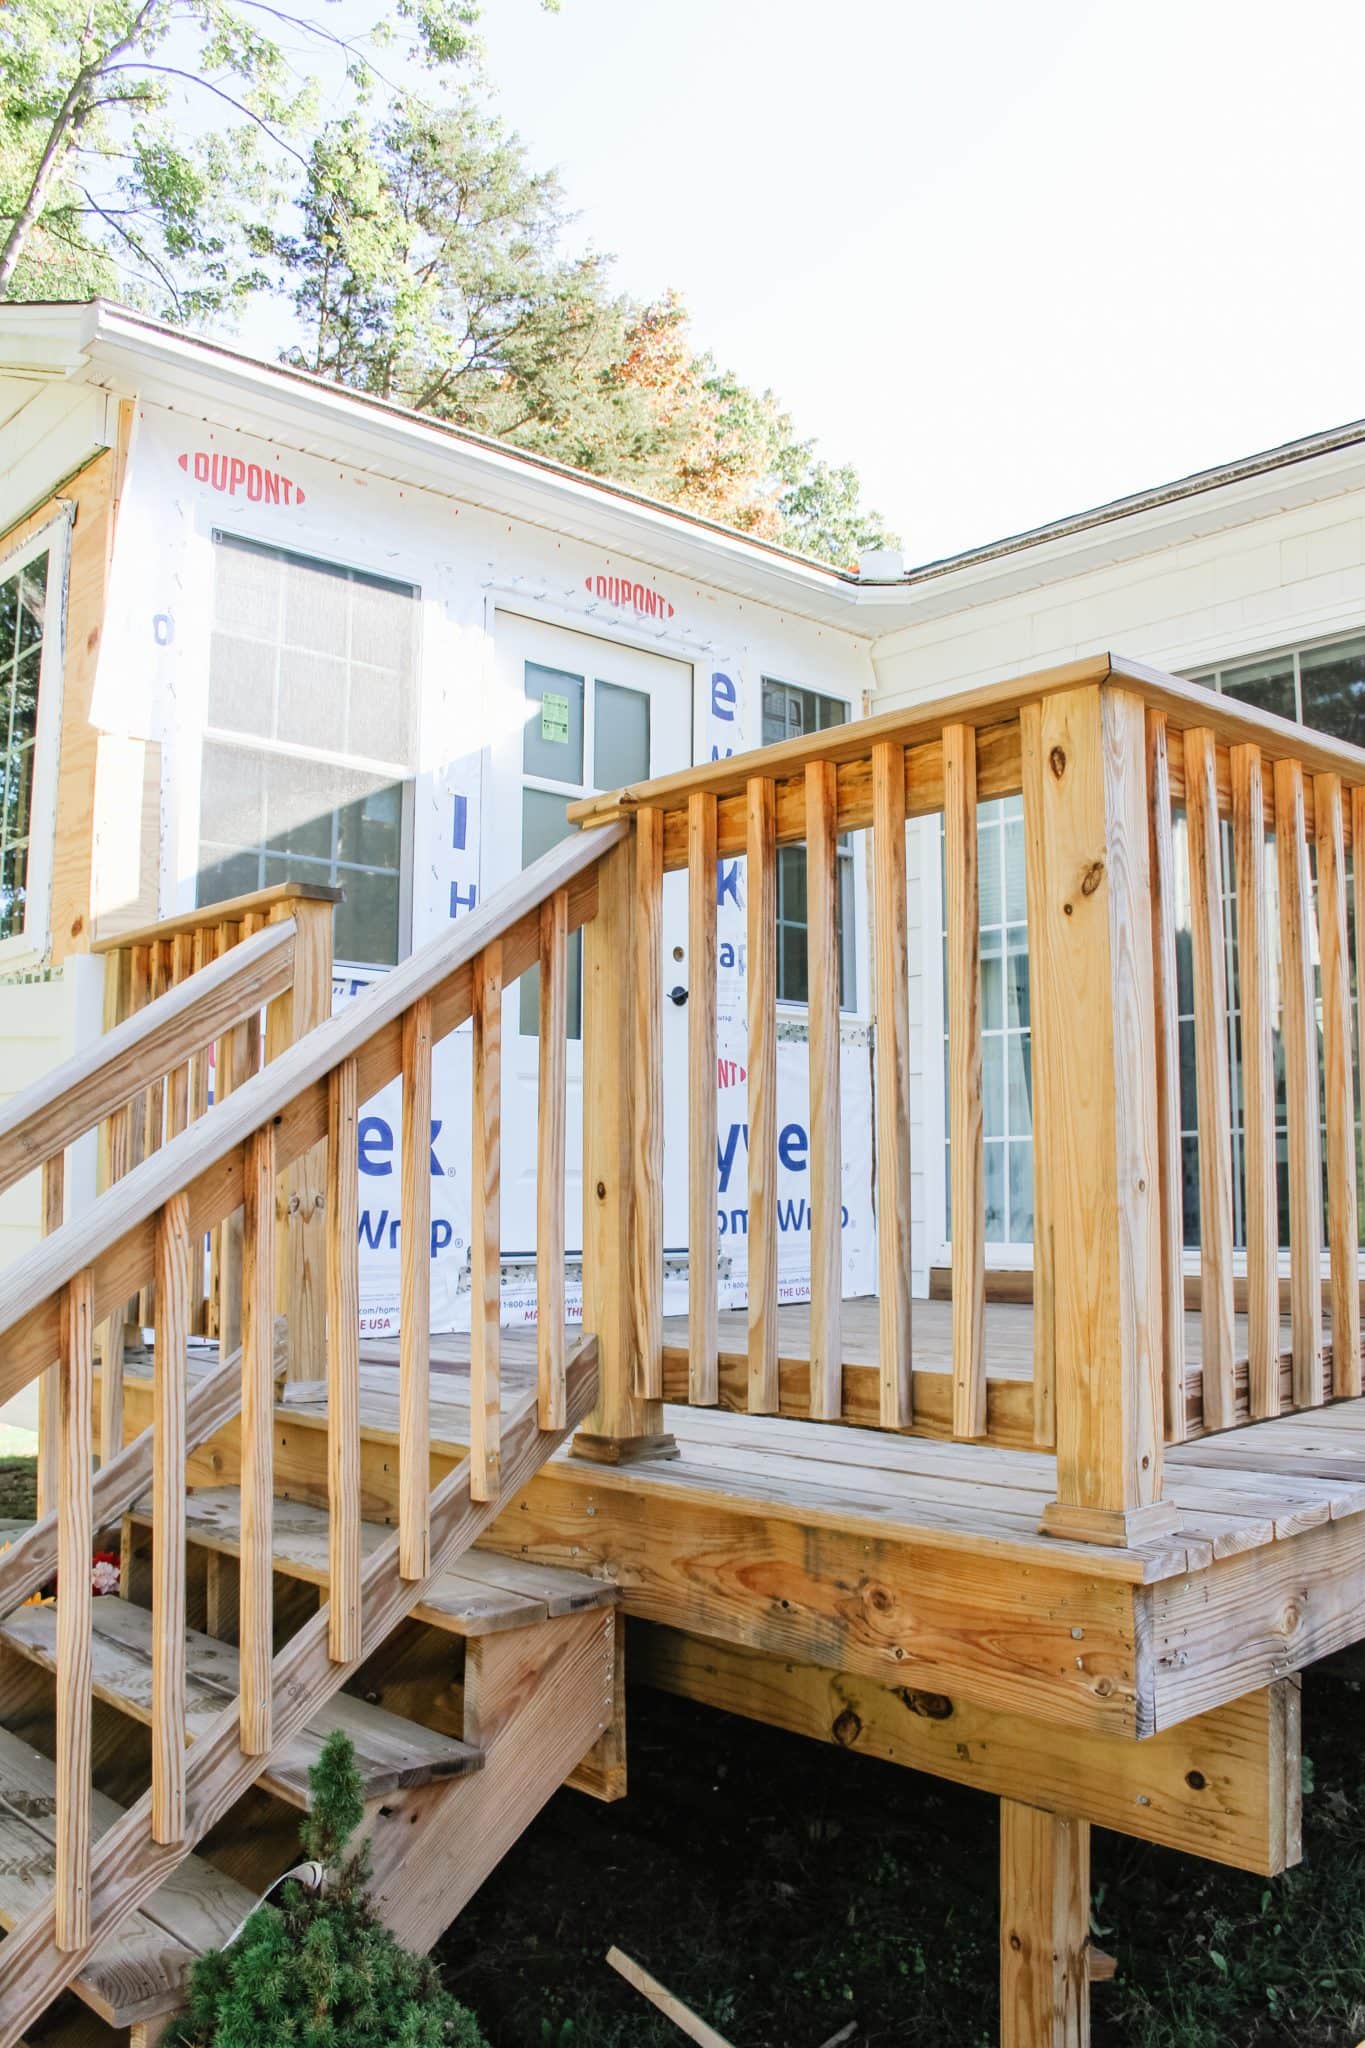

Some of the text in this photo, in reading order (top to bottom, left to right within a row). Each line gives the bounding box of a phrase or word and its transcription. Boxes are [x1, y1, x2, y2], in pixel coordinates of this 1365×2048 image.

[194, 452, 292, 505] DUPONT
[596, 575, 666, 620] DUPONT
[779, 1286, 810, 1297] THE USA
[369, 1318, 391, 1329] USA
